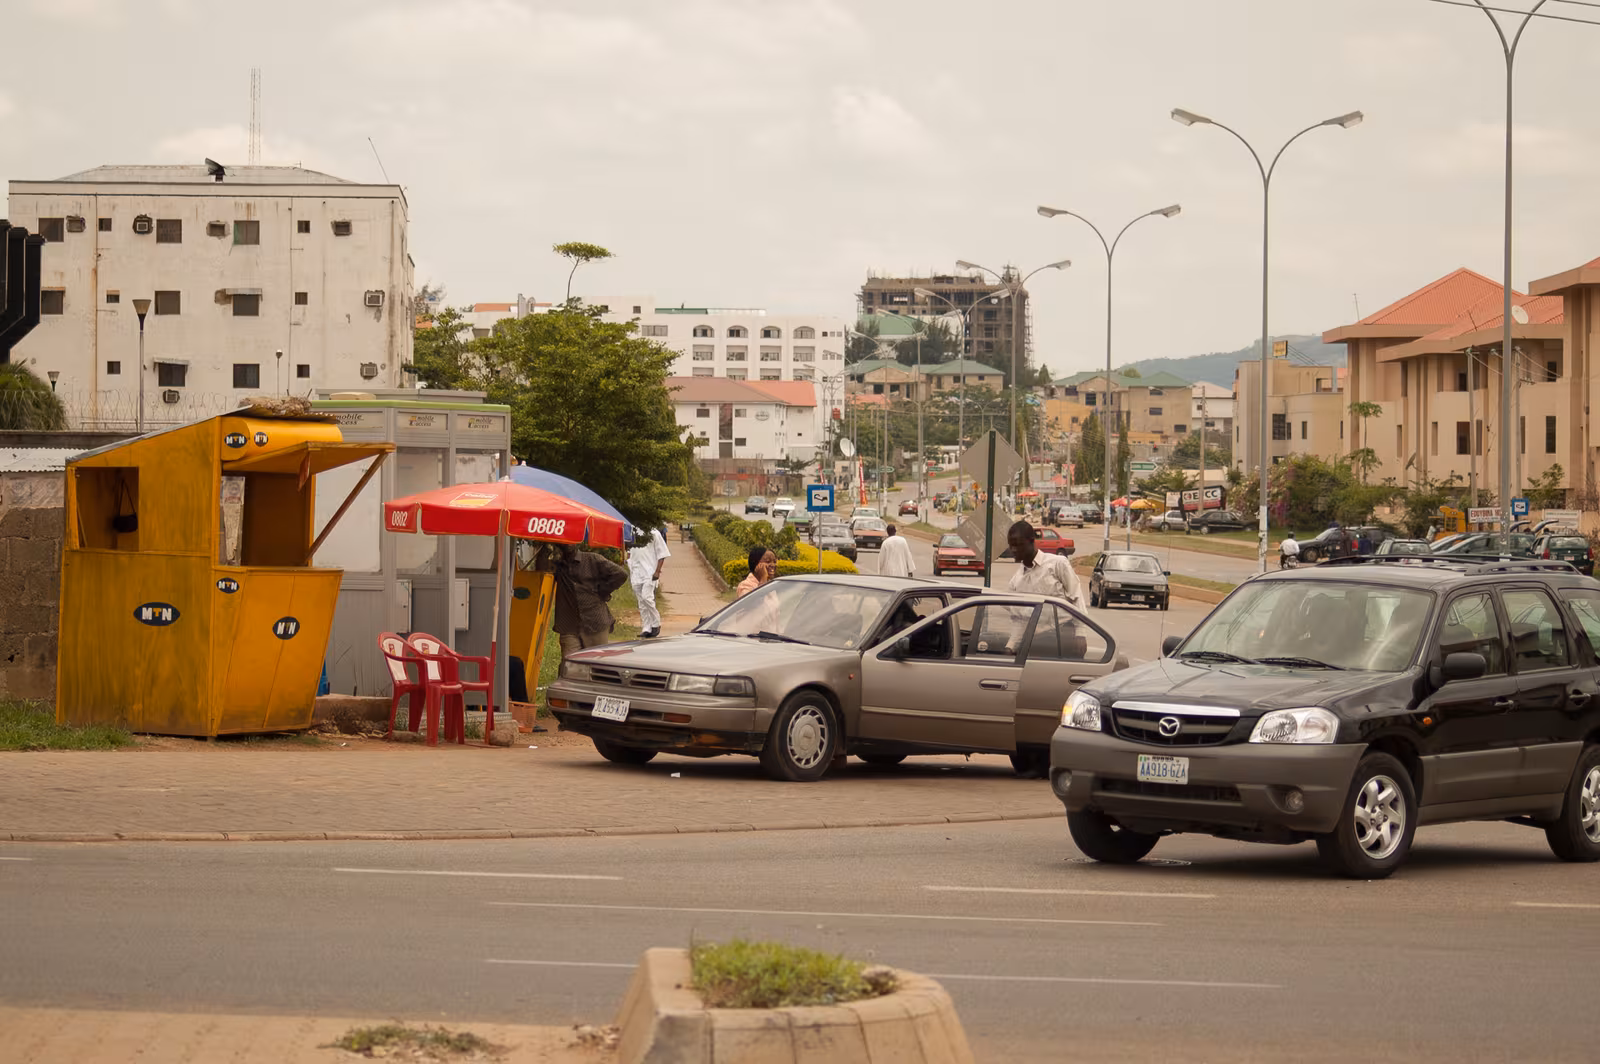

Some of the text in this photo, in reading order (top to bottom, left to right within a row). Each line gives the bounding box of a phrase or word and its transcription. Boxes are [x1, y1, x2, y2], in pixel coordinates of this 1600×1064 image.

[226, 435, 245, 444] MTN
[255, 434, 267, 443] MTN
[391, 510, 408, 527] 0802
[527, 516, 566, 536] 0808
[218, 580, 237, 591] MTN
[141, 606, 172, 622] MTN
[276, 621, 297, 635] MTN
[1140, 762, 1186, 778] AA918-GZA
